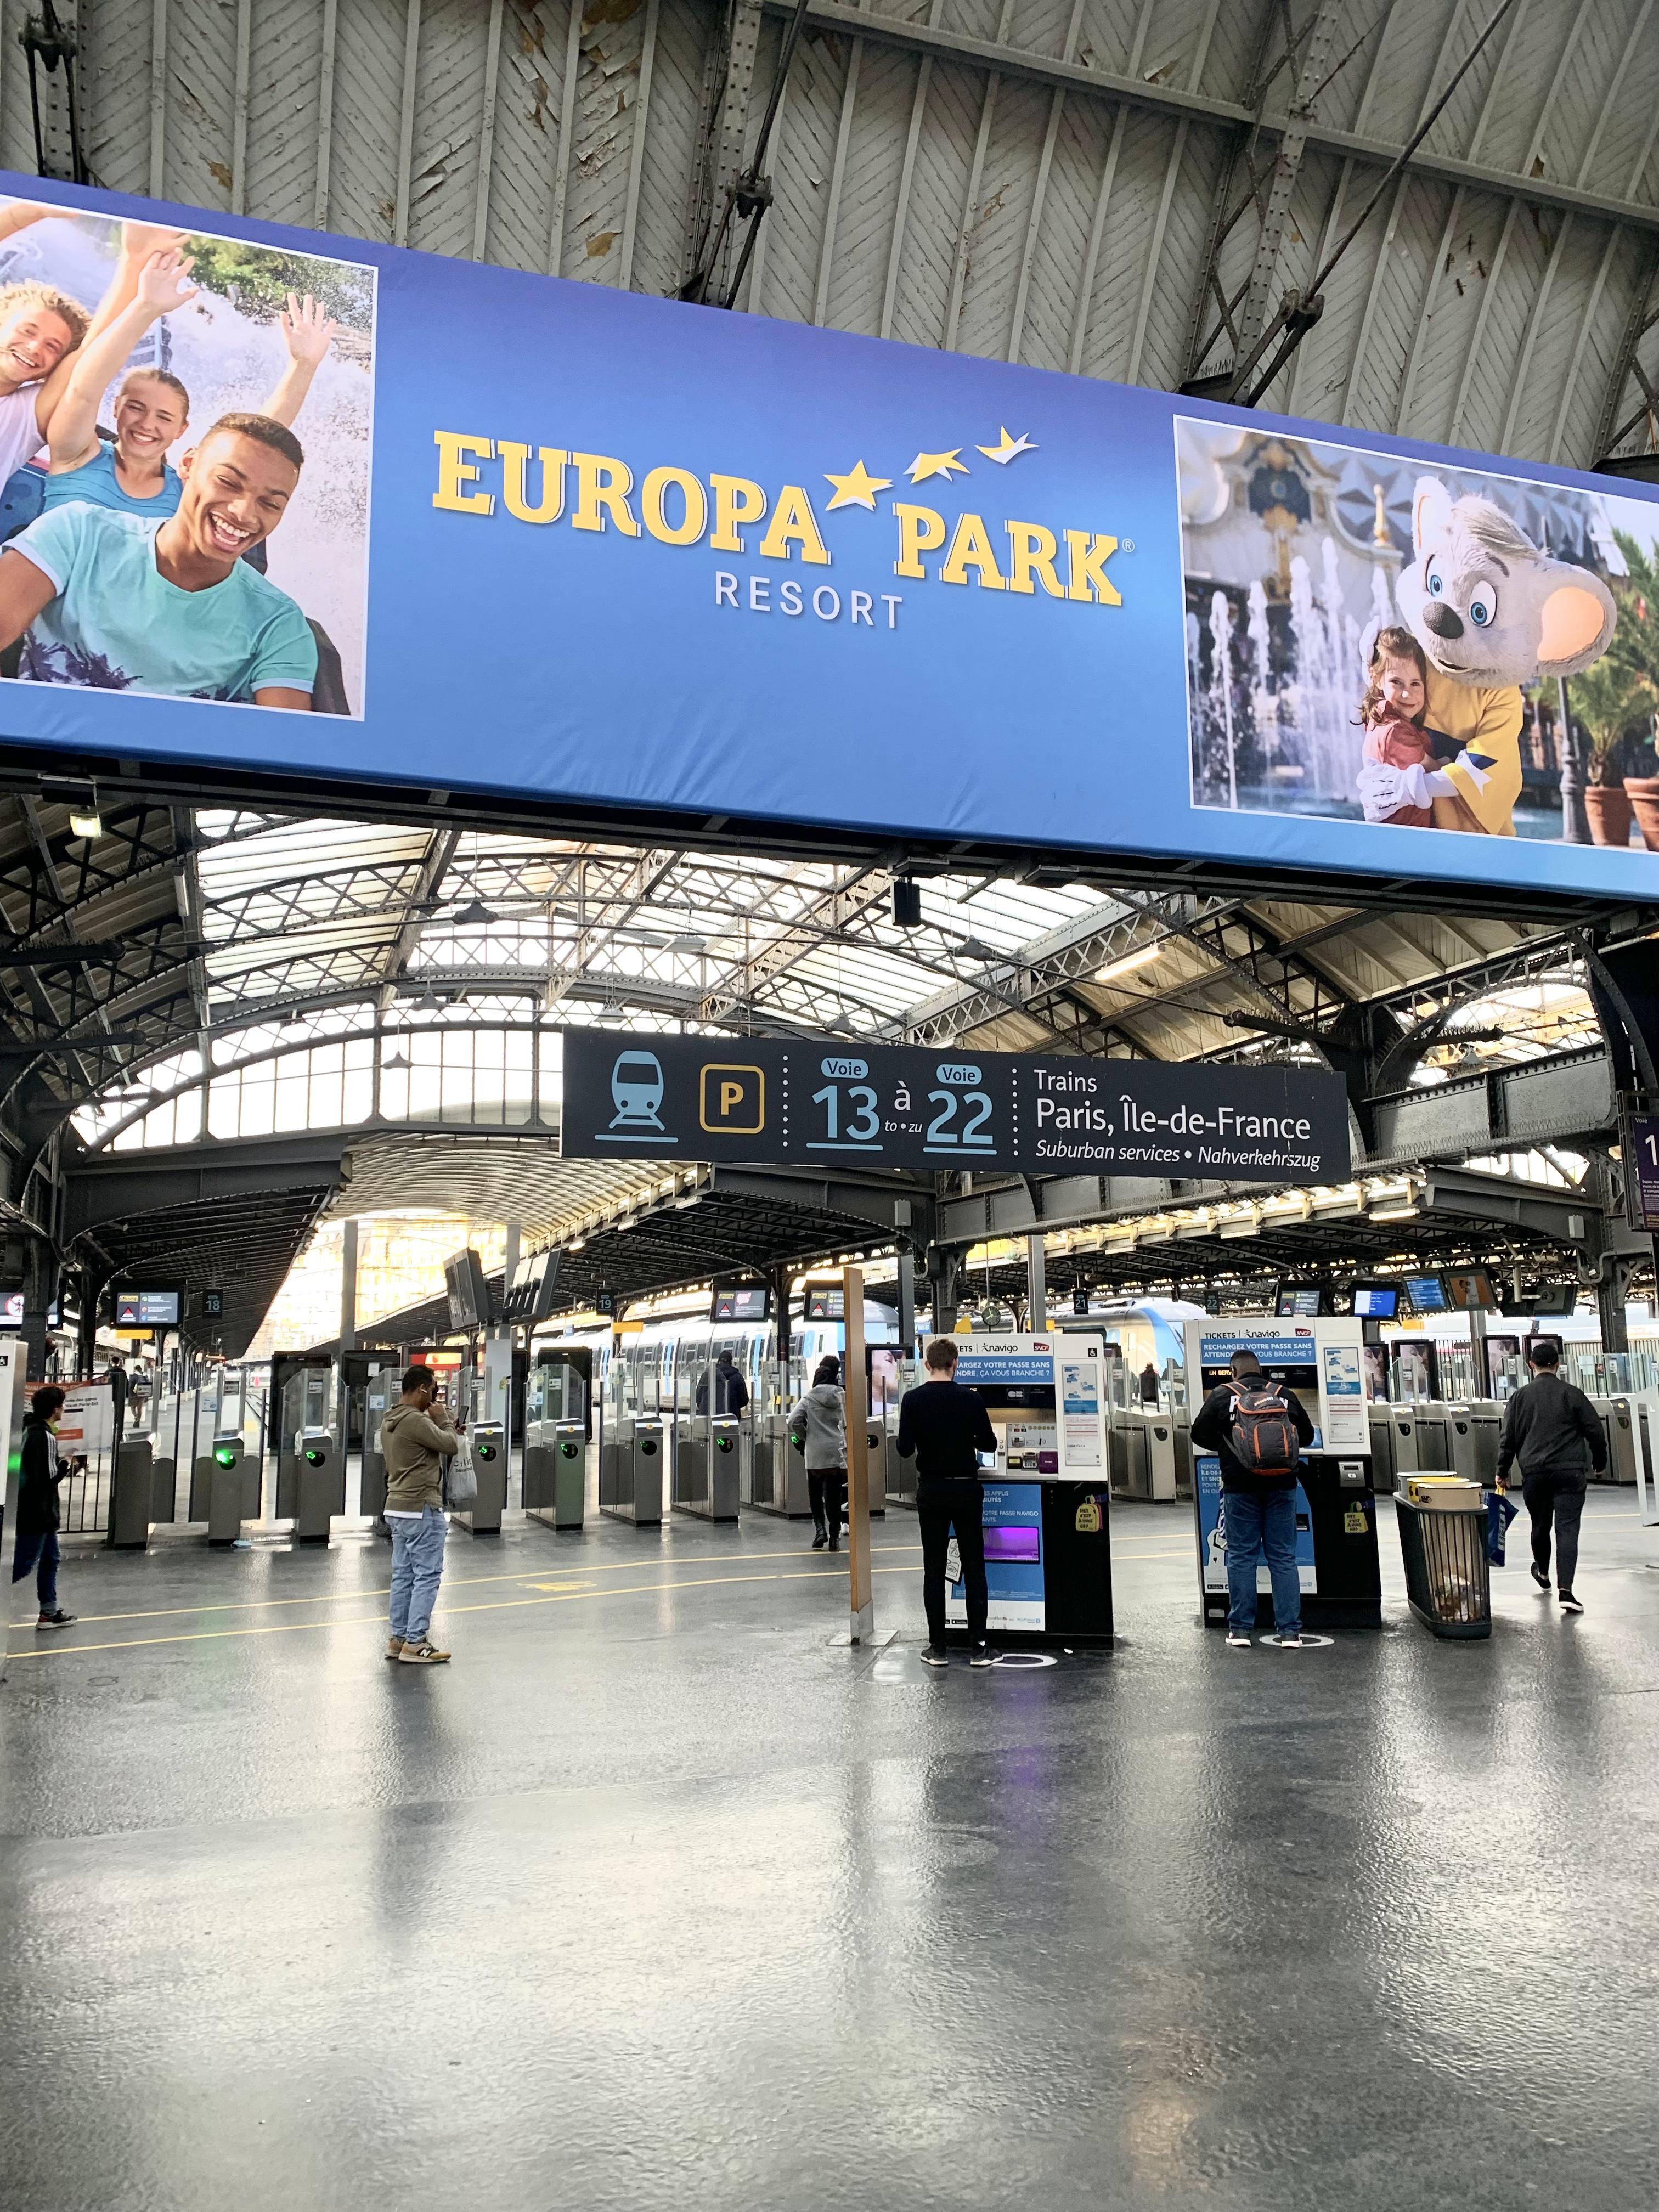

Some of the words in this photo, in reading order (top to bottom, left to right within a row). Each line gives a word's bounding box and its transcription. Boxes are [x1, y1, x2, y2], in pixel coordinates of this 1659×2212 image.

[432, 430, 831, 566] EUROPA
[715, 571, 902, 629] RESORT
[826, 1060, 862, 1078] Voie
[942, 1066, 976, 1084] Voie
[1034, 1069, 1097, 1092] Trains
[811, 1085, 880, 1141] 13
[894, 1081, 912, 1111] à
[927, 1090, 994, 1145] 22
[1036, 1097, 1114, 1137] Paris,
[1119, 1095, 1311, 1140] Île-de-France
[884, 1119, 898, 1133] to
[908, 1122, 923, 1134] zu
[1036, 1139, 1114, 1160] Suburban
[1119, 1145, 1180, 1163] services
[1198, 1146, 1320, 1172] Nahverkehrszug
[206, 1300, 220, 1310] 18
[599, 1299, 611, 1309] 19
[1075, 1299, 1086, 1308] 21
[1207, 1299, 1217, 1308] 22
[988, 1344, 1018, 1353] navigo
